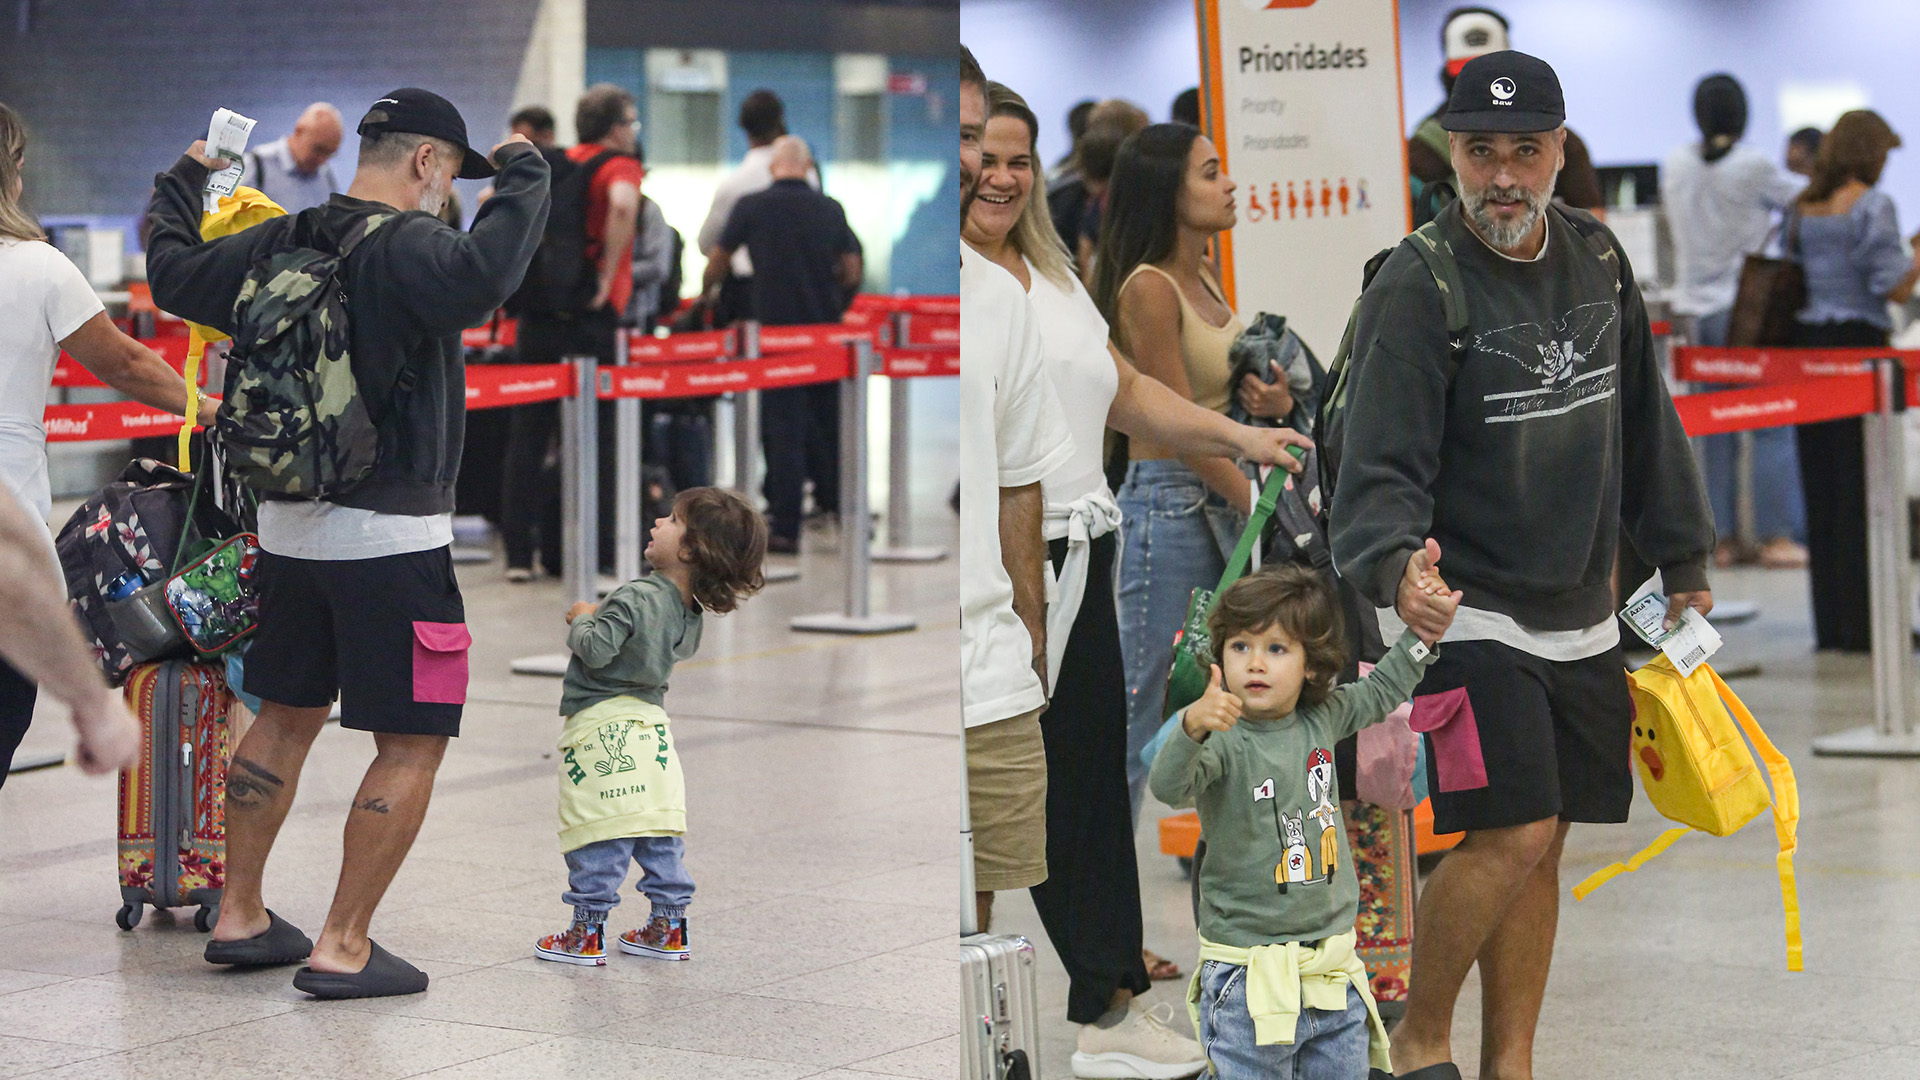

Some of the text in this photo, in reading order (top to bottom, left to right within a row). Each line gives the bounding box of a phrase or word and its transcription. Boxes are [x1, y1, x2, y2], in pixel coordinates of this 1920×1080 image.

[1239, 41, 1368, 73] Prioridades
[1629, 603, 1646, 617] Azul
[654, 723, 668, 771] DAY
[600, 784, 646, 800] PIZZA FAN
